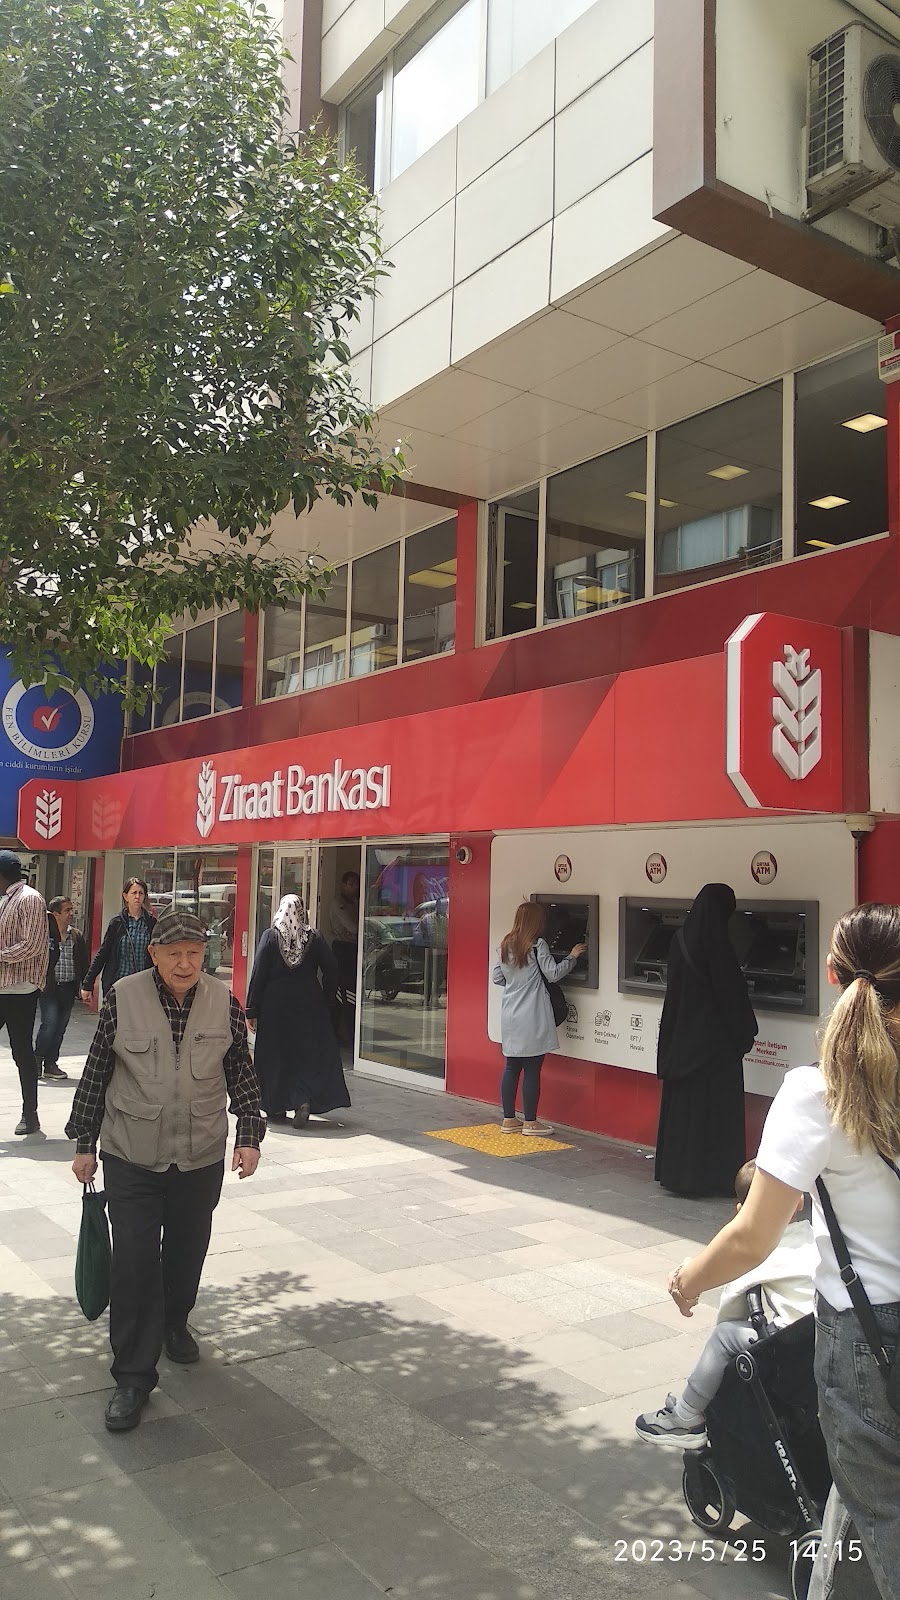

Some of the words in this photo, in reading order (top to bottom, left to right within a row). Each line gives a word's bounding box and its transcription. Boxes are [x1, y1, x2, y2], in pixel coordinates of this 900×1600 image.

[5, 707, 15, 729] FEN
[12, 733, 71, 759] BİLİMLERİ
[72, 715, 92, 749] KURSU
[5, 761, 24, 769] ciddi
[25, 762, 63, 772] kurumların
[64, 765, 83, 774] işidir
[218, 771, 285, 822] Ziraat
[286, 758, 391, 816] Bankası
[774, 1439, 797, 1483] KRAFT
[796, 1495, 812, 1523] Solid
